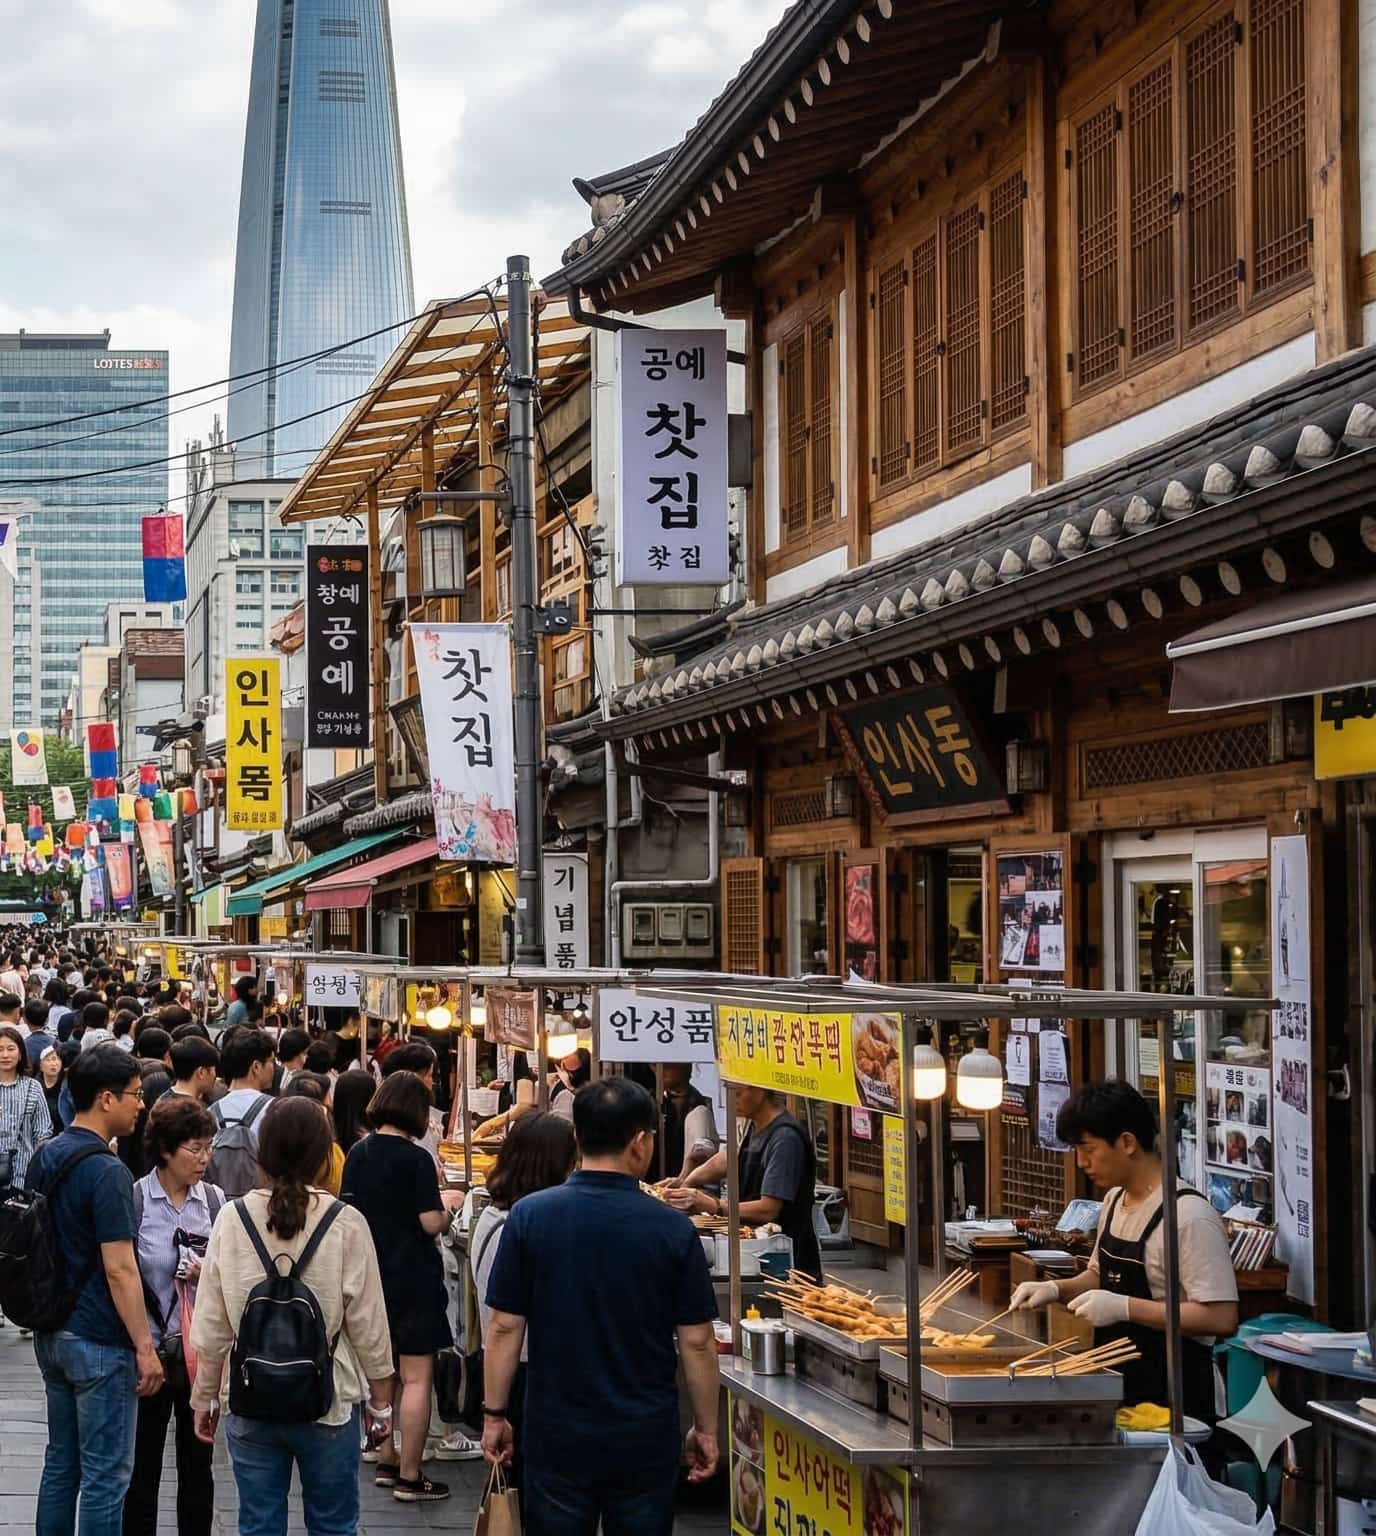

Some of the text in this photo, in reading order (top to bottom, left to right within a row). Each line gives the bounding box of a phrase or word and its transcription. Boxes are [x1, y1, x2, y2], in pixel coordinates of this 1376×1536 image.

[641, 347, 705, 380] 공예
[645, 402, 706, 529] 찻집
[322, 617, 357, 695] 공예
[442, 649, 493, 767] 찻집
[863, 705, 977, 797] 인사동
[609, 1006, 713, 1044] 안성품
